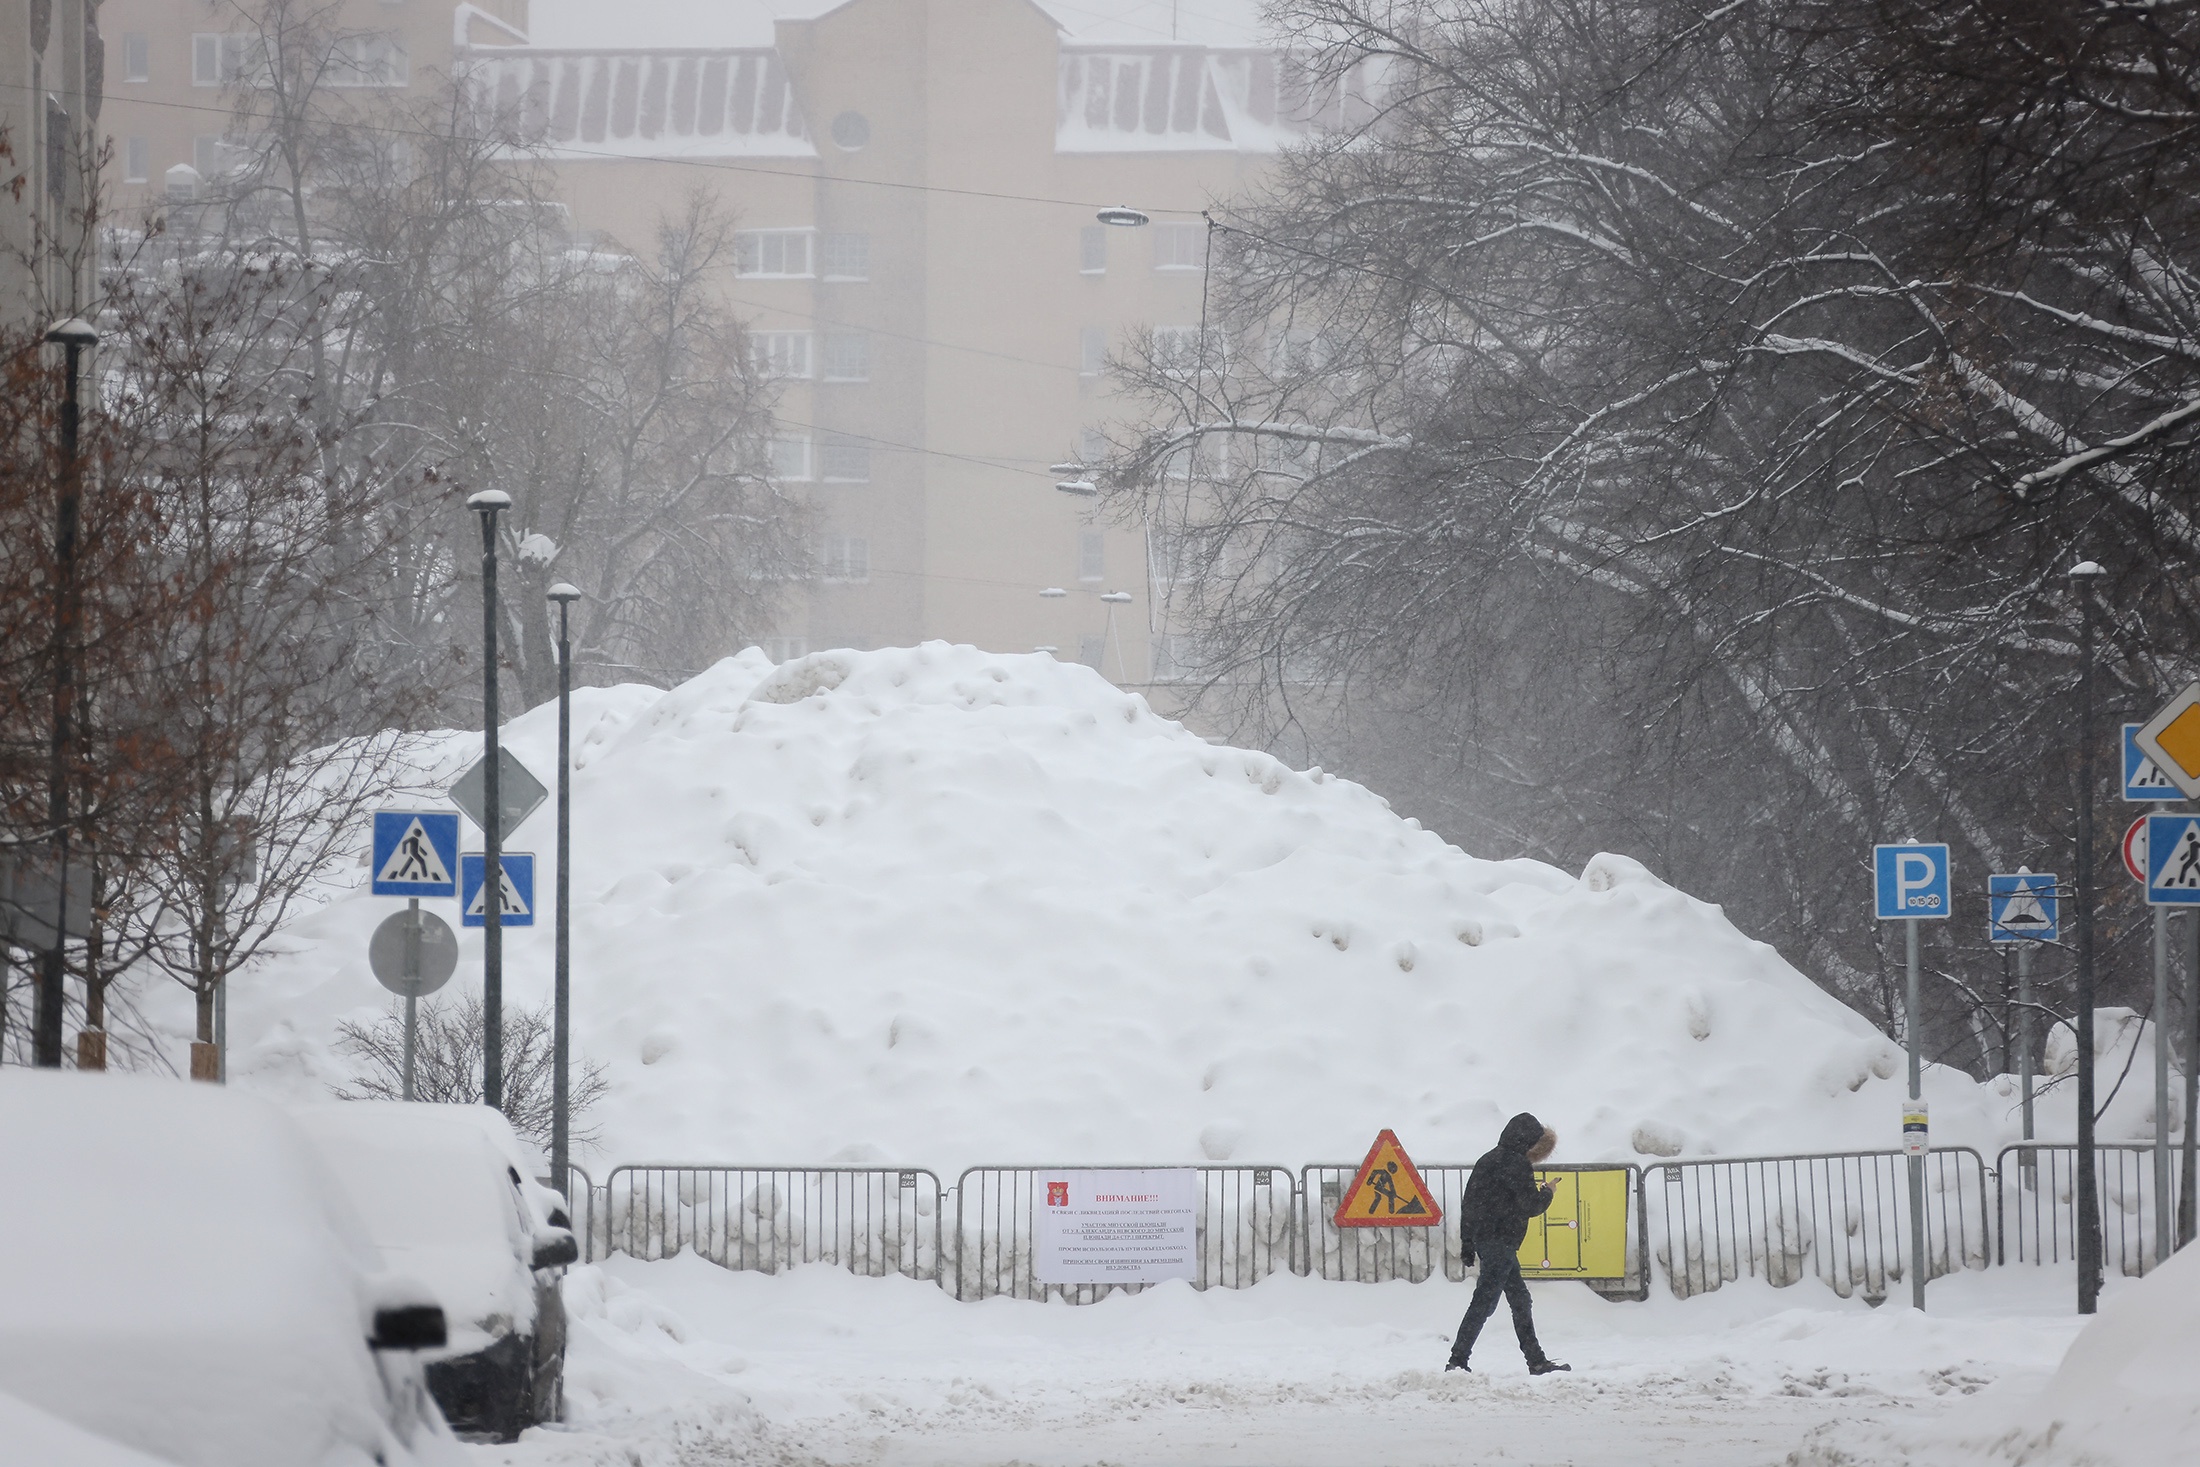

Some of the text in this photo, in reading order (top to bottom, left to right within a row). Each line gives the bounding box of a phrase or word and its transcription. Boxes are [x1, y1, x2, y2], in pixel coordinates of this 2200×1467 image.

[1896, 852, 1936, 910] P
[1927, 896, 1940, 906] 20
[1095, 1194, 1159, 1203] ВНИМАНИЕ!!!
